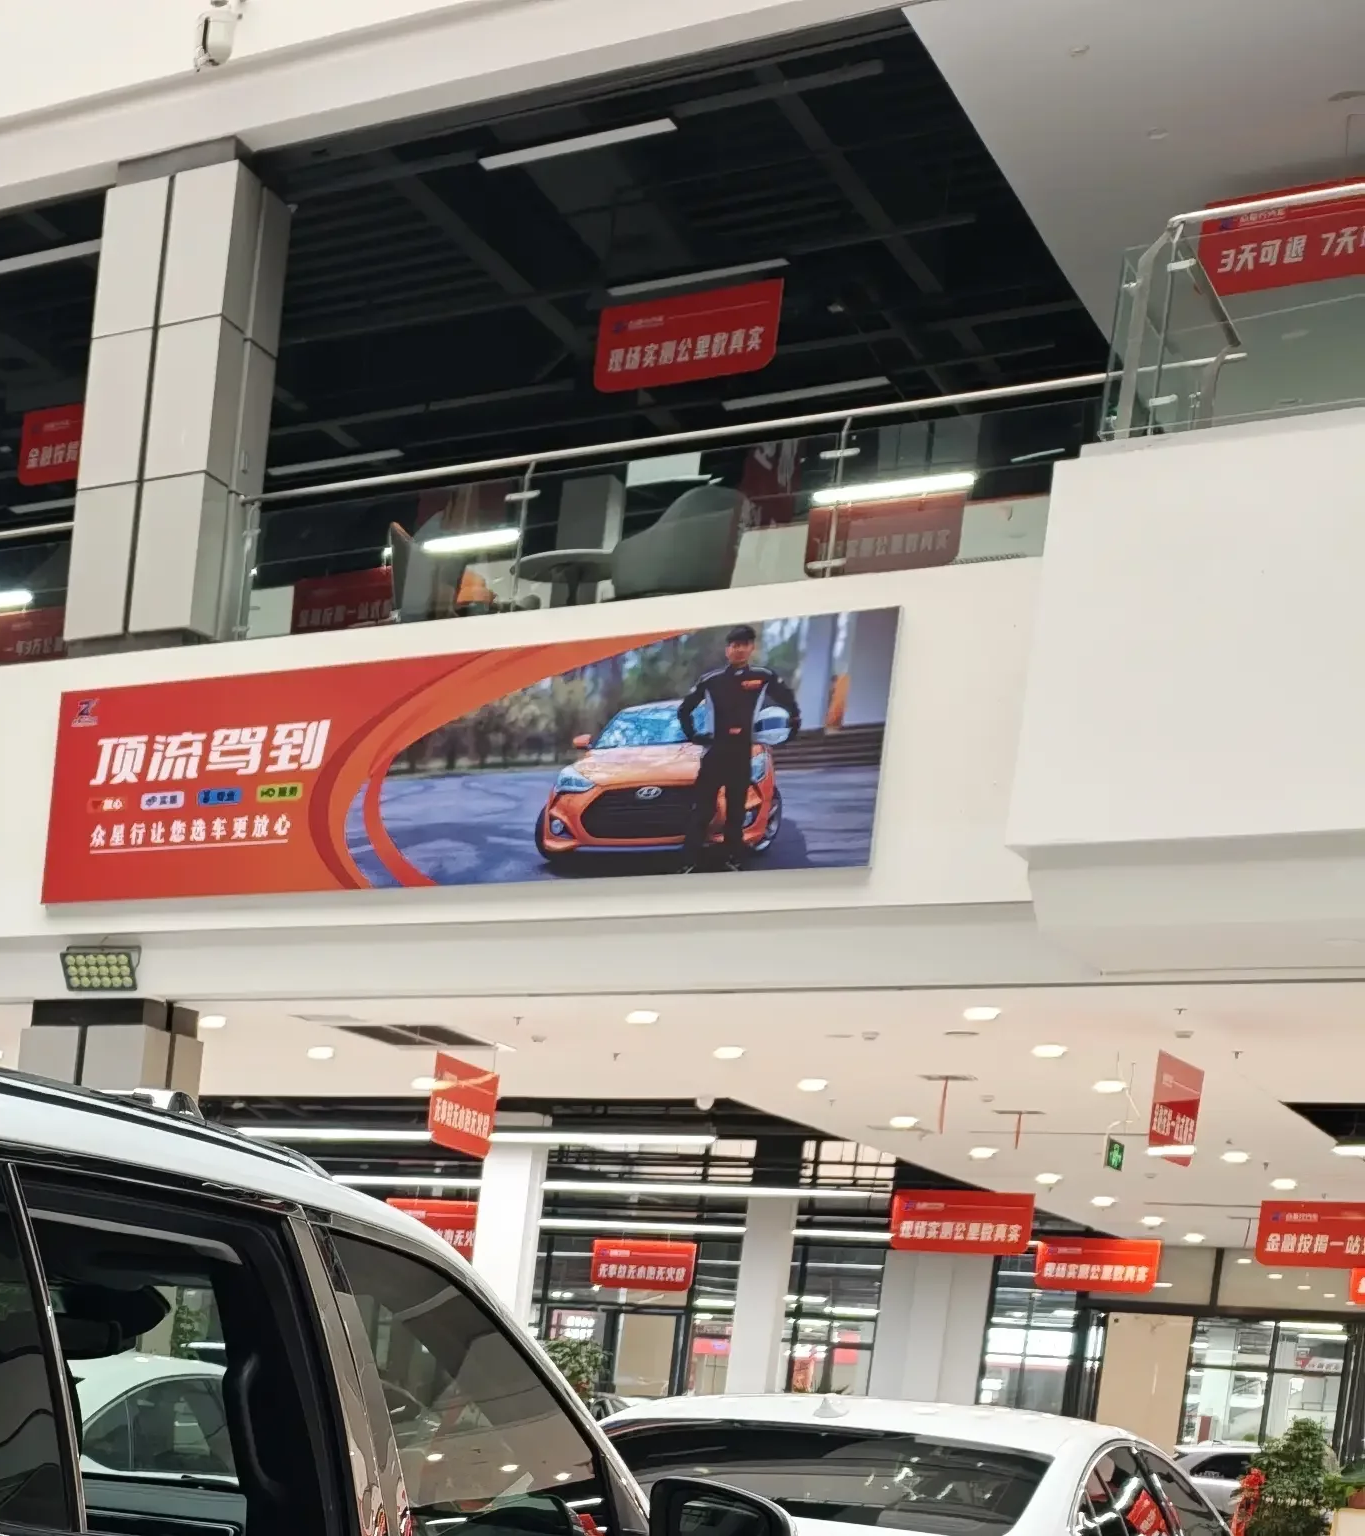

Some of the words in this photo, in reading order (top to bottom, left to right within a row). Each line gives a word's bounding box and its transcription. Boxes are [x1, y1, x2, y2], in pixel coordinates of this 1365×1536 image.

[1217, 234, 1307, 274] 3天可退
[1321, 226, 1365, 257] 7天
[608, 326, 765, 372] 现场实测公里数真实
[90, 719, 332, 786] 顶流驾到
[90, 814, 292, 847] 众星行让您选车更放心
[899, 1219, 1023, 1243] 现场实测公里数真实
[1265, 1233, 1365, 1256] 金融按揭一站
